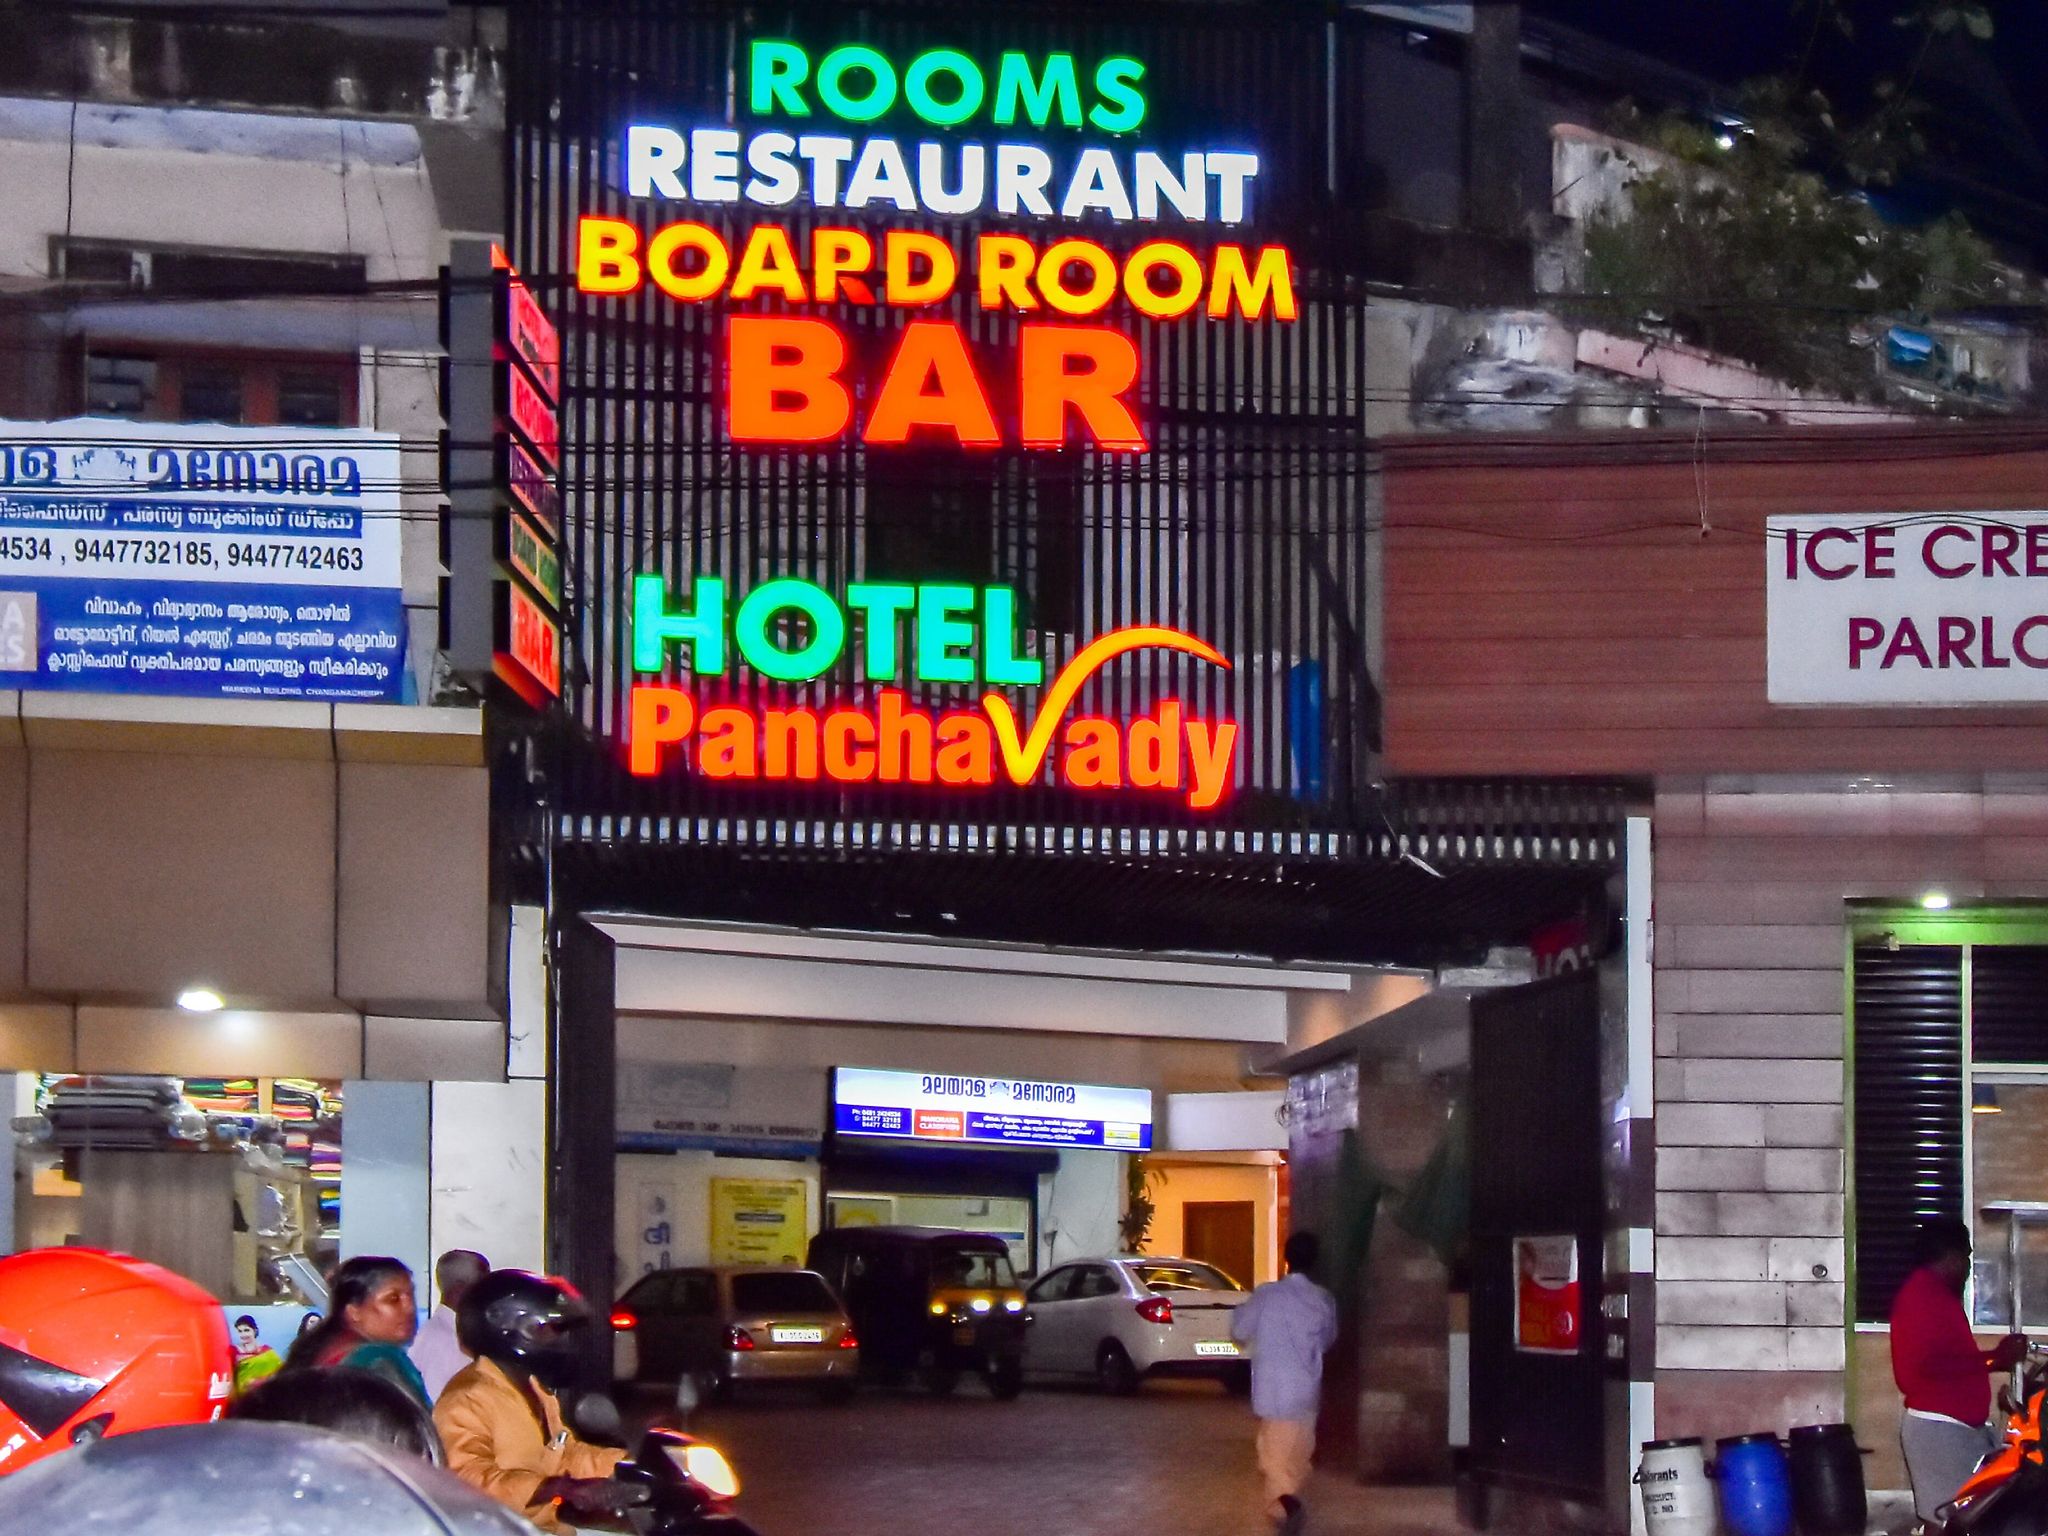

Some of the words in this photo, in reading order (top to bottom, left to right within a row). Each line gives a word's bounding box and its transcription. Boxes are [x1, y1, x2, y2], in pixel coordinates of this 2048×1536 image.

[750, 40, 1147, 134] ROOMS
[626, 125, 1259, 224] RESTAURANT
[577, 217, 958, 306] BOARD
[978, 235, 1298, 323] ROOM
[727, 315, 1150, 453] BAR
[148, 447, 361, 498] മനോരമ
[228, 542, 363, 571] 9447742463
[1786, 526, 1896, 580] ICE
[1922, 525, 2048, 579] CRE
[631, 575, 1044, 686] HOTEL
[1849, 615, 2048, 669] PARLO
[922, 1076, 986, 1098] മലയാള
[1013, 1082, 1076, 1104] മനോരമ
